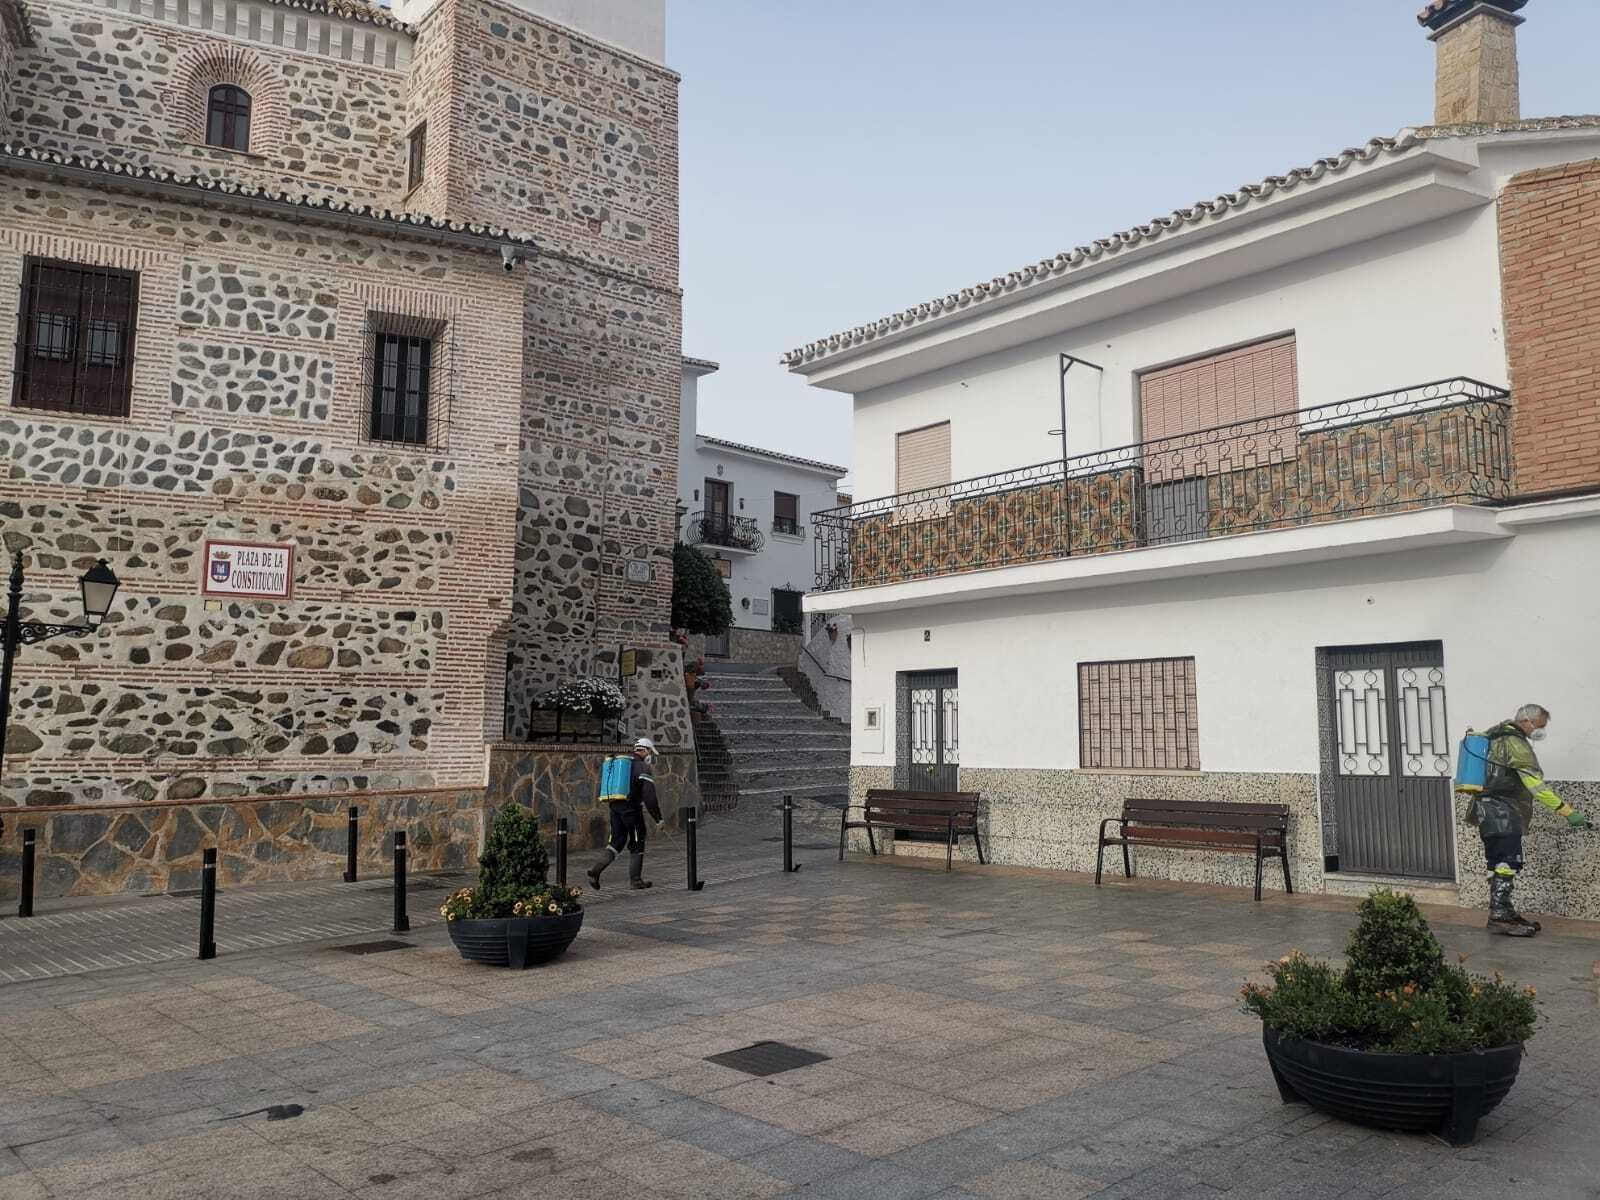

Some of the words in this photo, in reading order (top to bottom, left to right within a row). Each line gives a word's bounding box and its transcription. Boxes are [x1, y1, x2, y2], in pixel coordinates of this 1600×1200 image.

[237, 551, 259, 566] PLAZA
[262, 552, 272, 567] DE
[274, 553, 283, 568] LA
